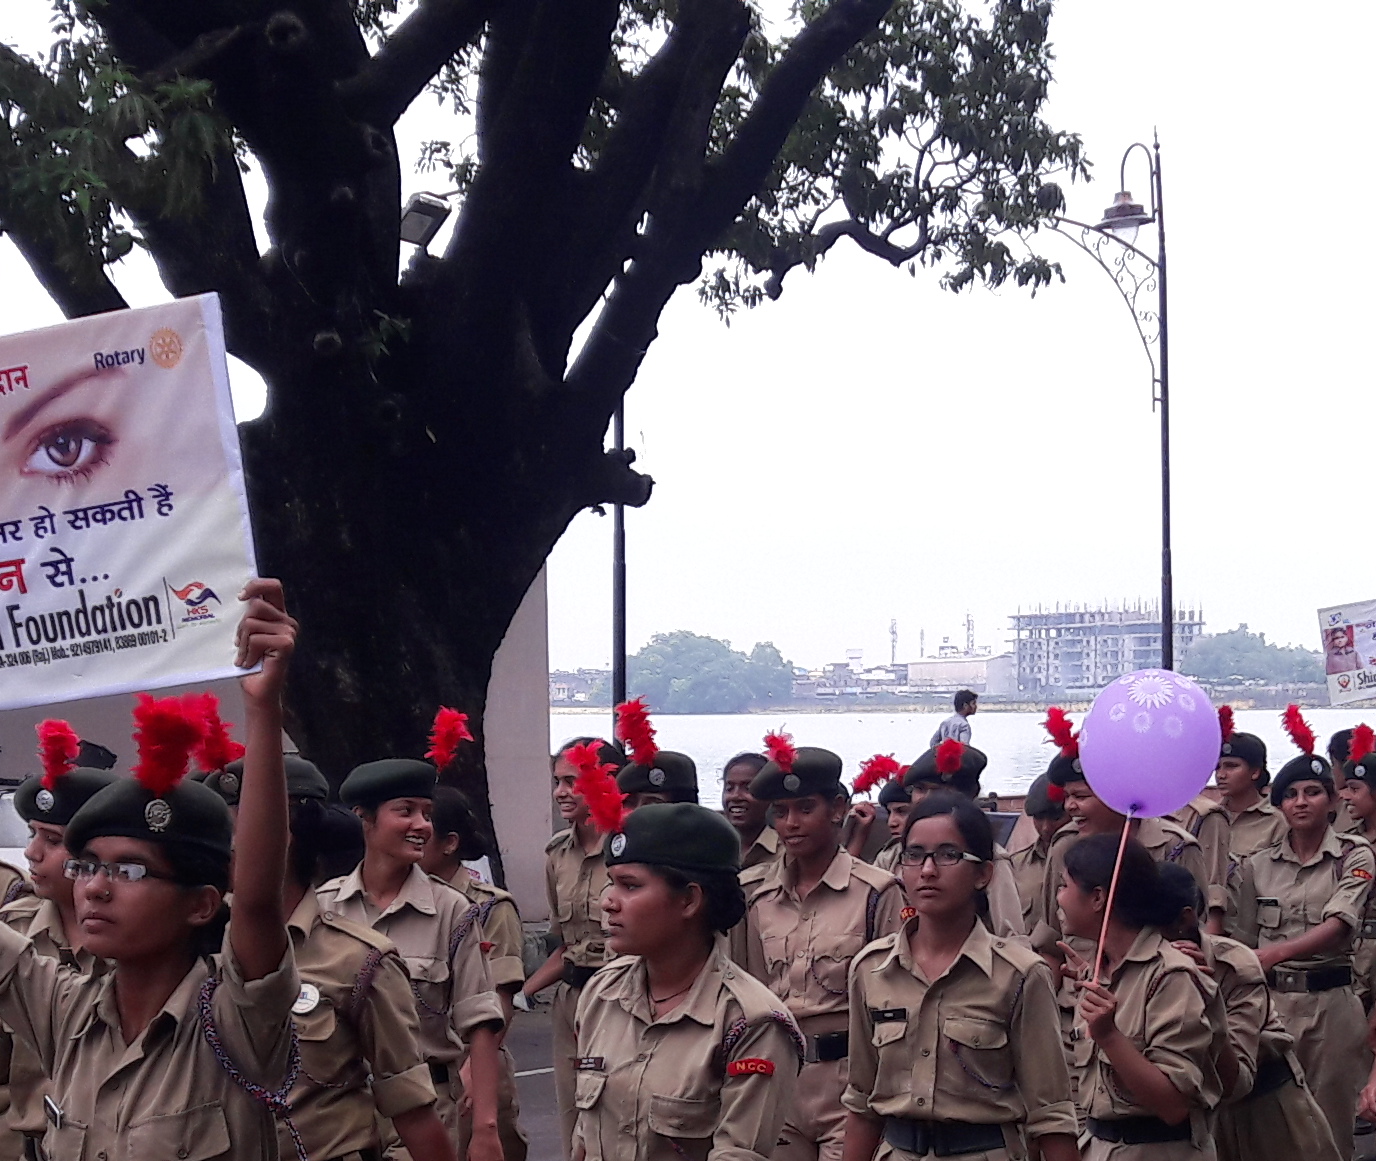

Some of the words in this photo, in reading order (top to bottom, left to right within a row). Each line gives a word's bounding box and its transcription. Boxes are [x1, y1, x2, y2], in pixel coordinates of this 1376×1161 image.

[93, 347, 145, 370] Rotary
[29, 506, 57, 539] हो
[63, 490, 144, 530] सकती
[147, 483, 173, 517] हैं
[40, 547, 110, 588] से...
[6, 587, 162, 649] Foundation
[736, 1062, 766, 1072] NCC
